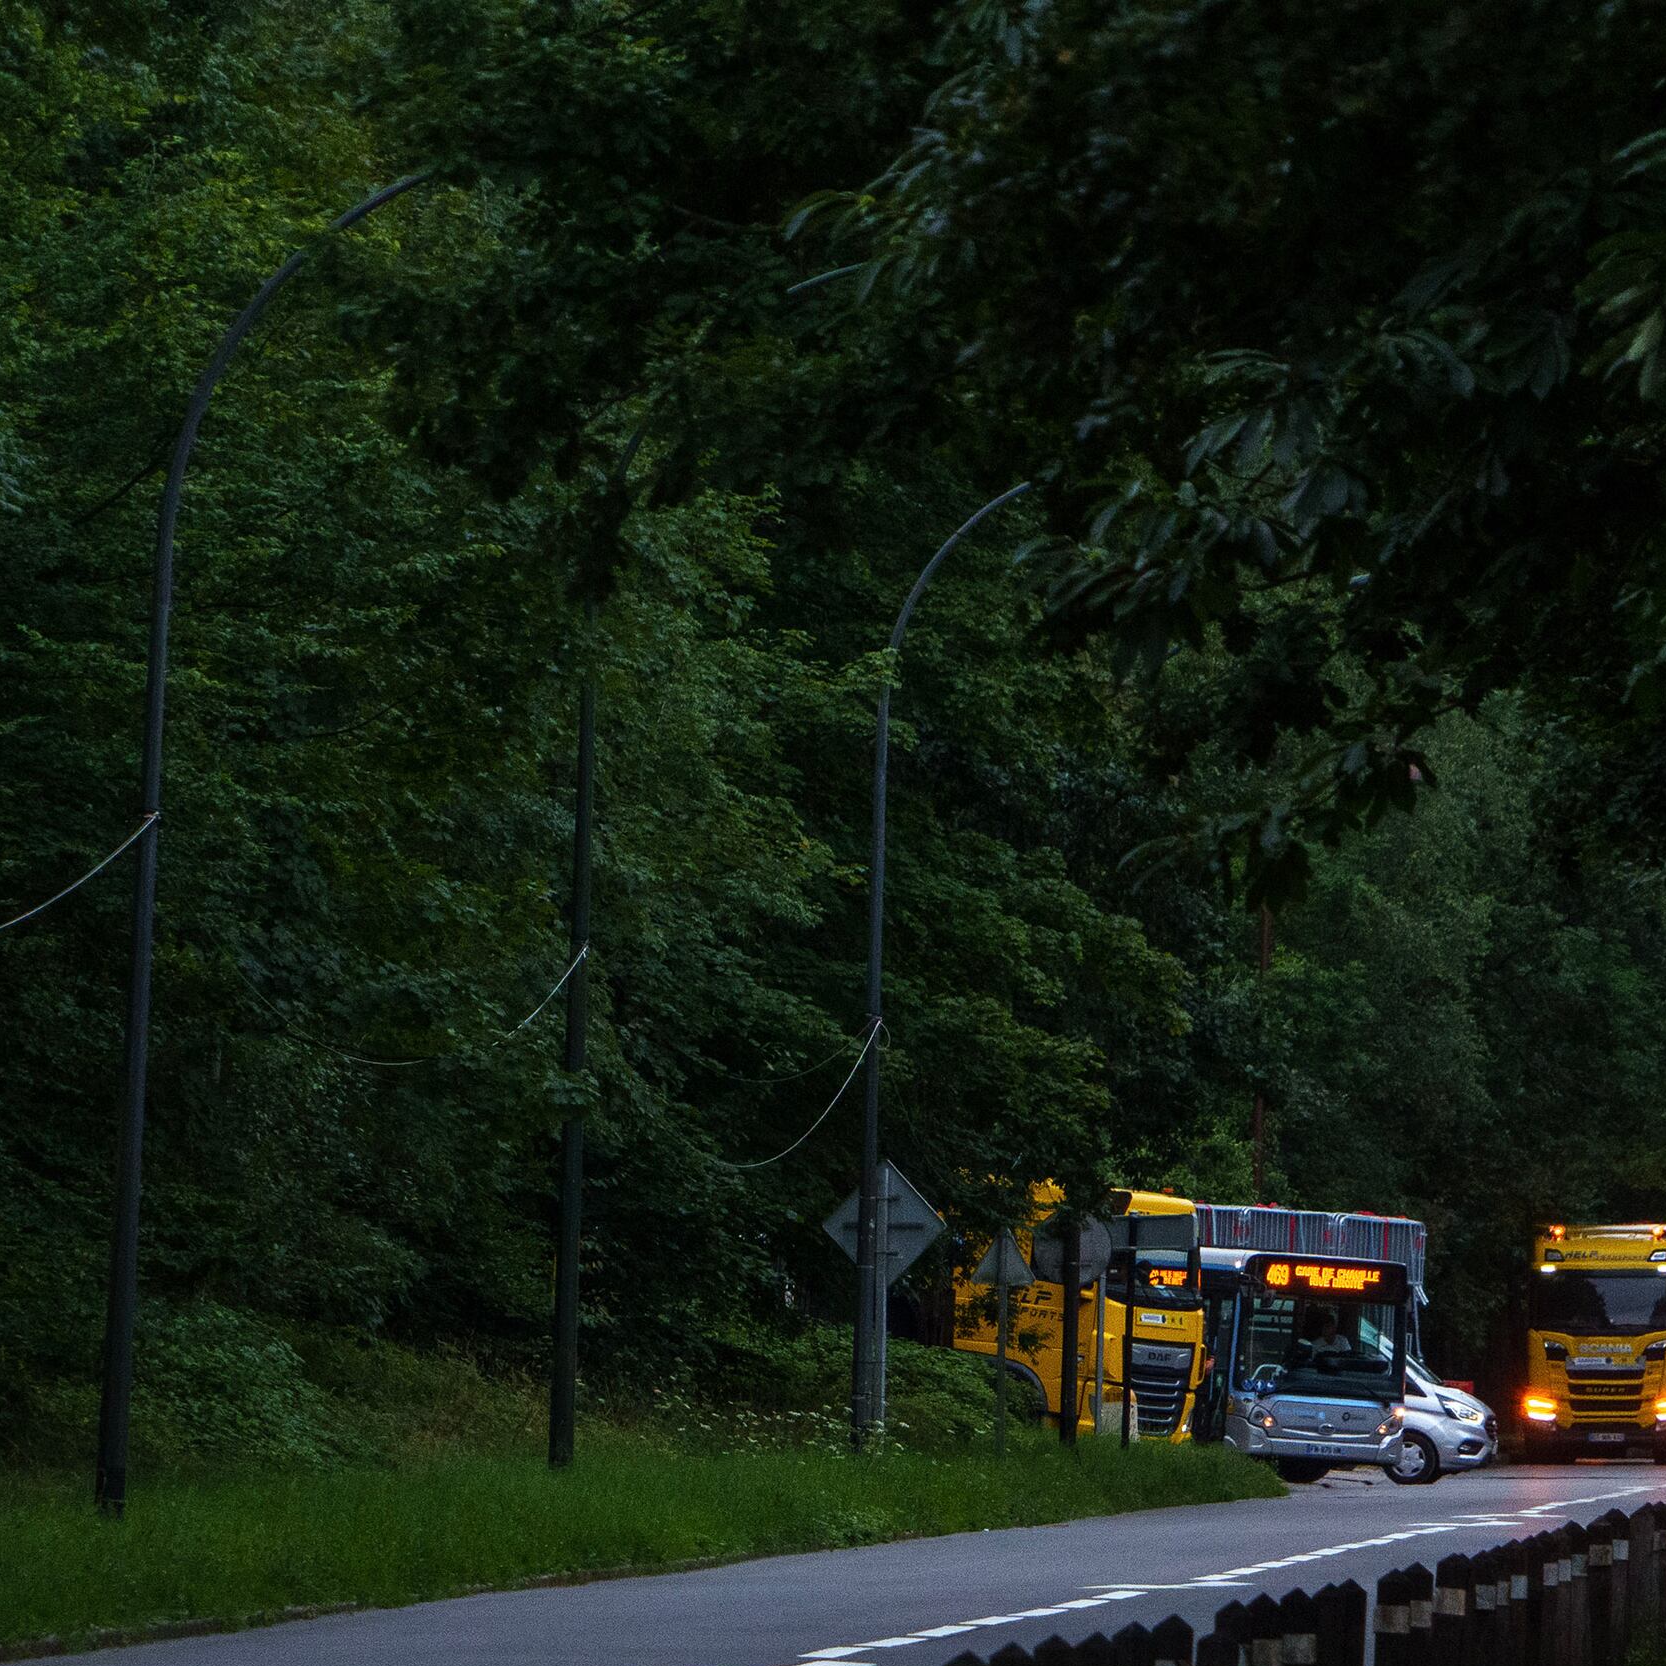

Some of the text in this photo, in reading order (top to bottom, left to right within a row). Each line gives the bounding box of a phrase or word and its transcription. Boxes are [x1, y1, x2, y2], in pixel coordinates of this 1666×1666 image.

[1266, 1264, 1289, 1285] 469
[1295, 1266, 1320, 1278] GARE
[1321, 1268, 1334, 1279] DE
[1309, 1277, 1364, 1290] RIVE DROITE
[1148, 1352, 1172, 1362] DAF
[1585, 1386, 1626, 1394] SUPER
